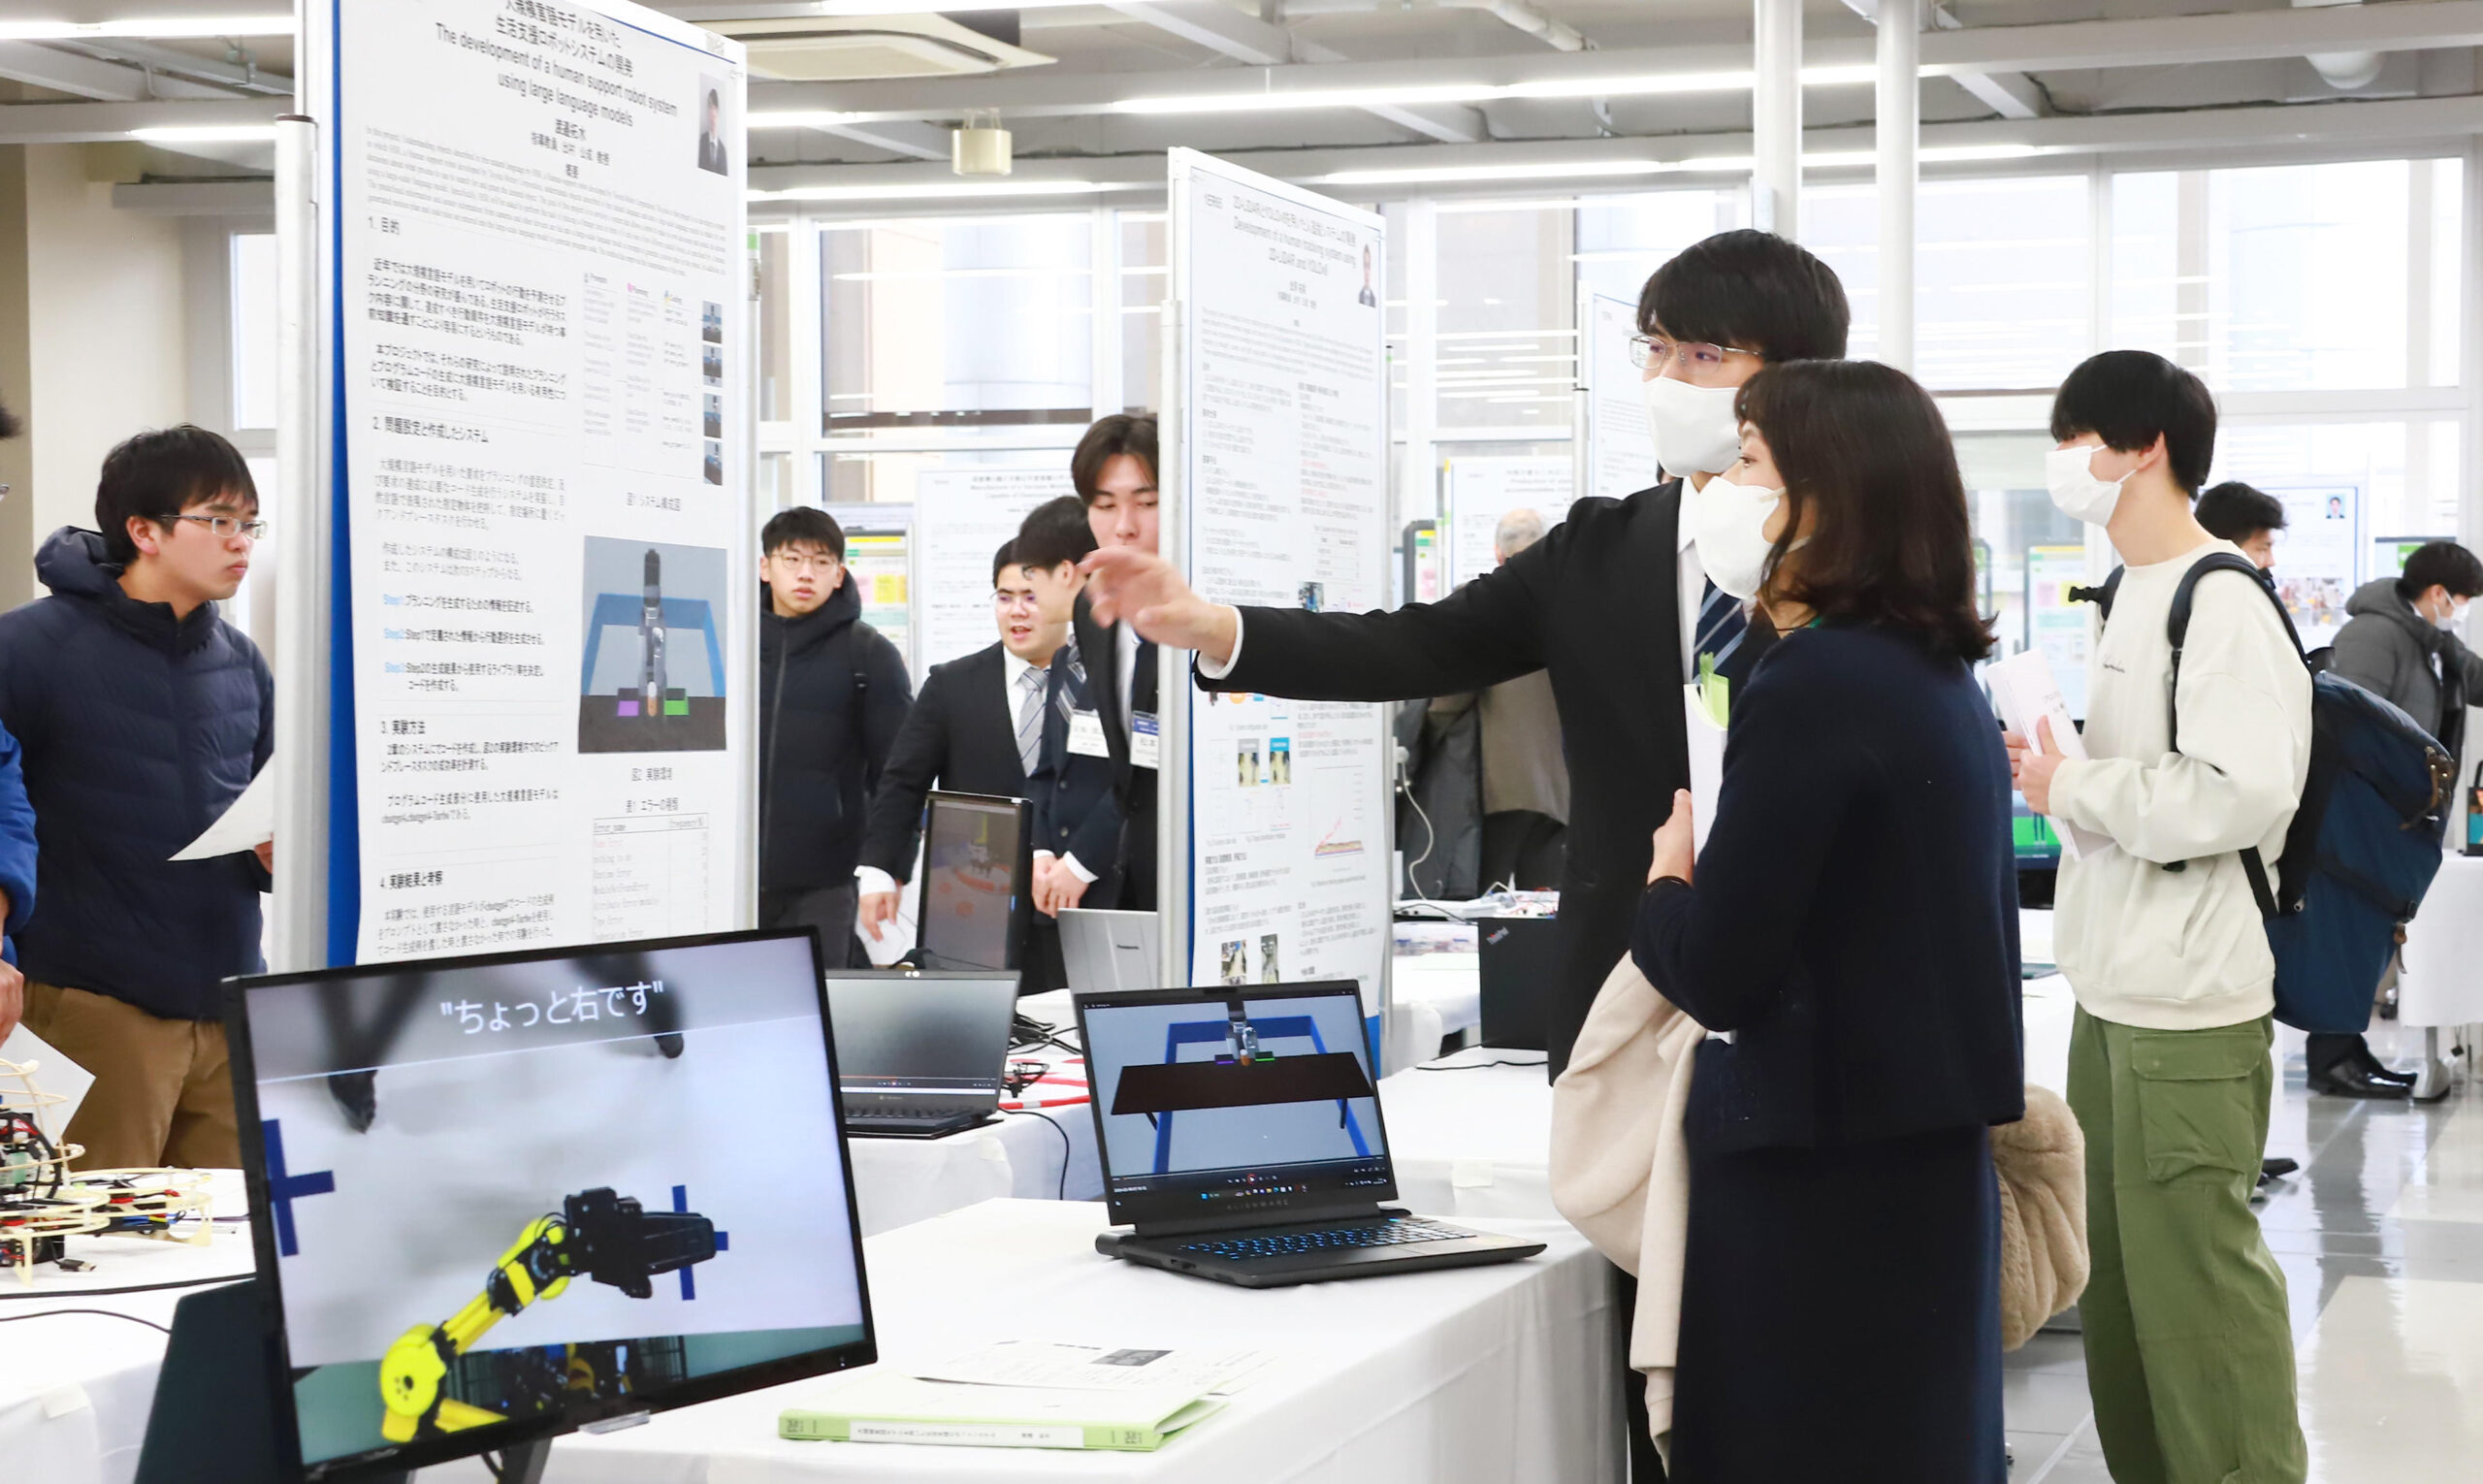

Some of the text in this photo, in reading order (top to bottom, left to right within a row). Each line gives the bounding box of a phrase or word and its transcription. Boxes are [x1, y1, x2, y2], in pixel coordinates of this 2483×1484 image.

[497, 14, 633, 78] 生活支援ロボットシステムの開発
[435, 22, 677, 116] The development of a human support robot system
[499, 73, 633, 127] using large language models
[381, 216, 399, 235] 目的
[1234, 215, 1272, 241] Development
[393, 721, 425, 733] 実験方法
[389, 871, 442, 887] 実験結果と考察
[440, 981, 663, 1034] "ちょっと右です"
[1226, 1199, 1289, 1211] ALIENWARE
